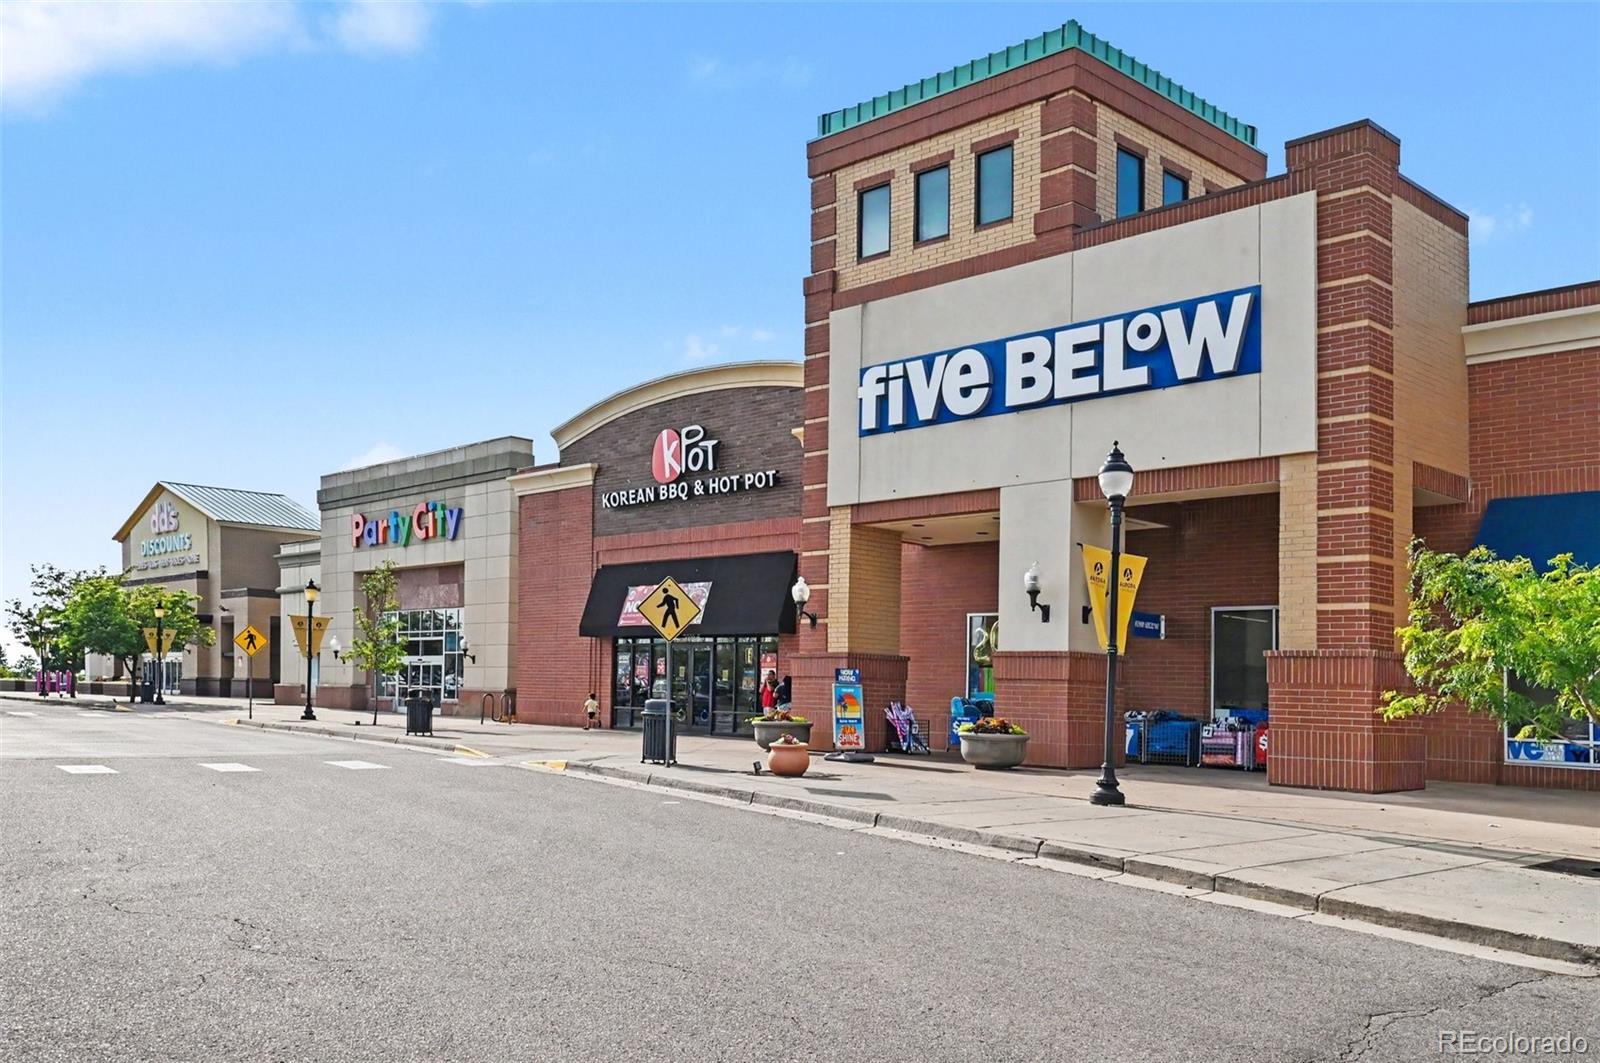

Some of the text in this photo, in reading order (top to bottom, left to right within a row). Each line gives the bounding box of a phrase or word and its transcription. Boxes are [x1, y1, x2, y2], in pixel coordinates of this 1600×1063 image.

[602, 470, 776, 508] KOREAN BBQ & HOT POT
[141, 533, 192, 557] DISCOUNTS
